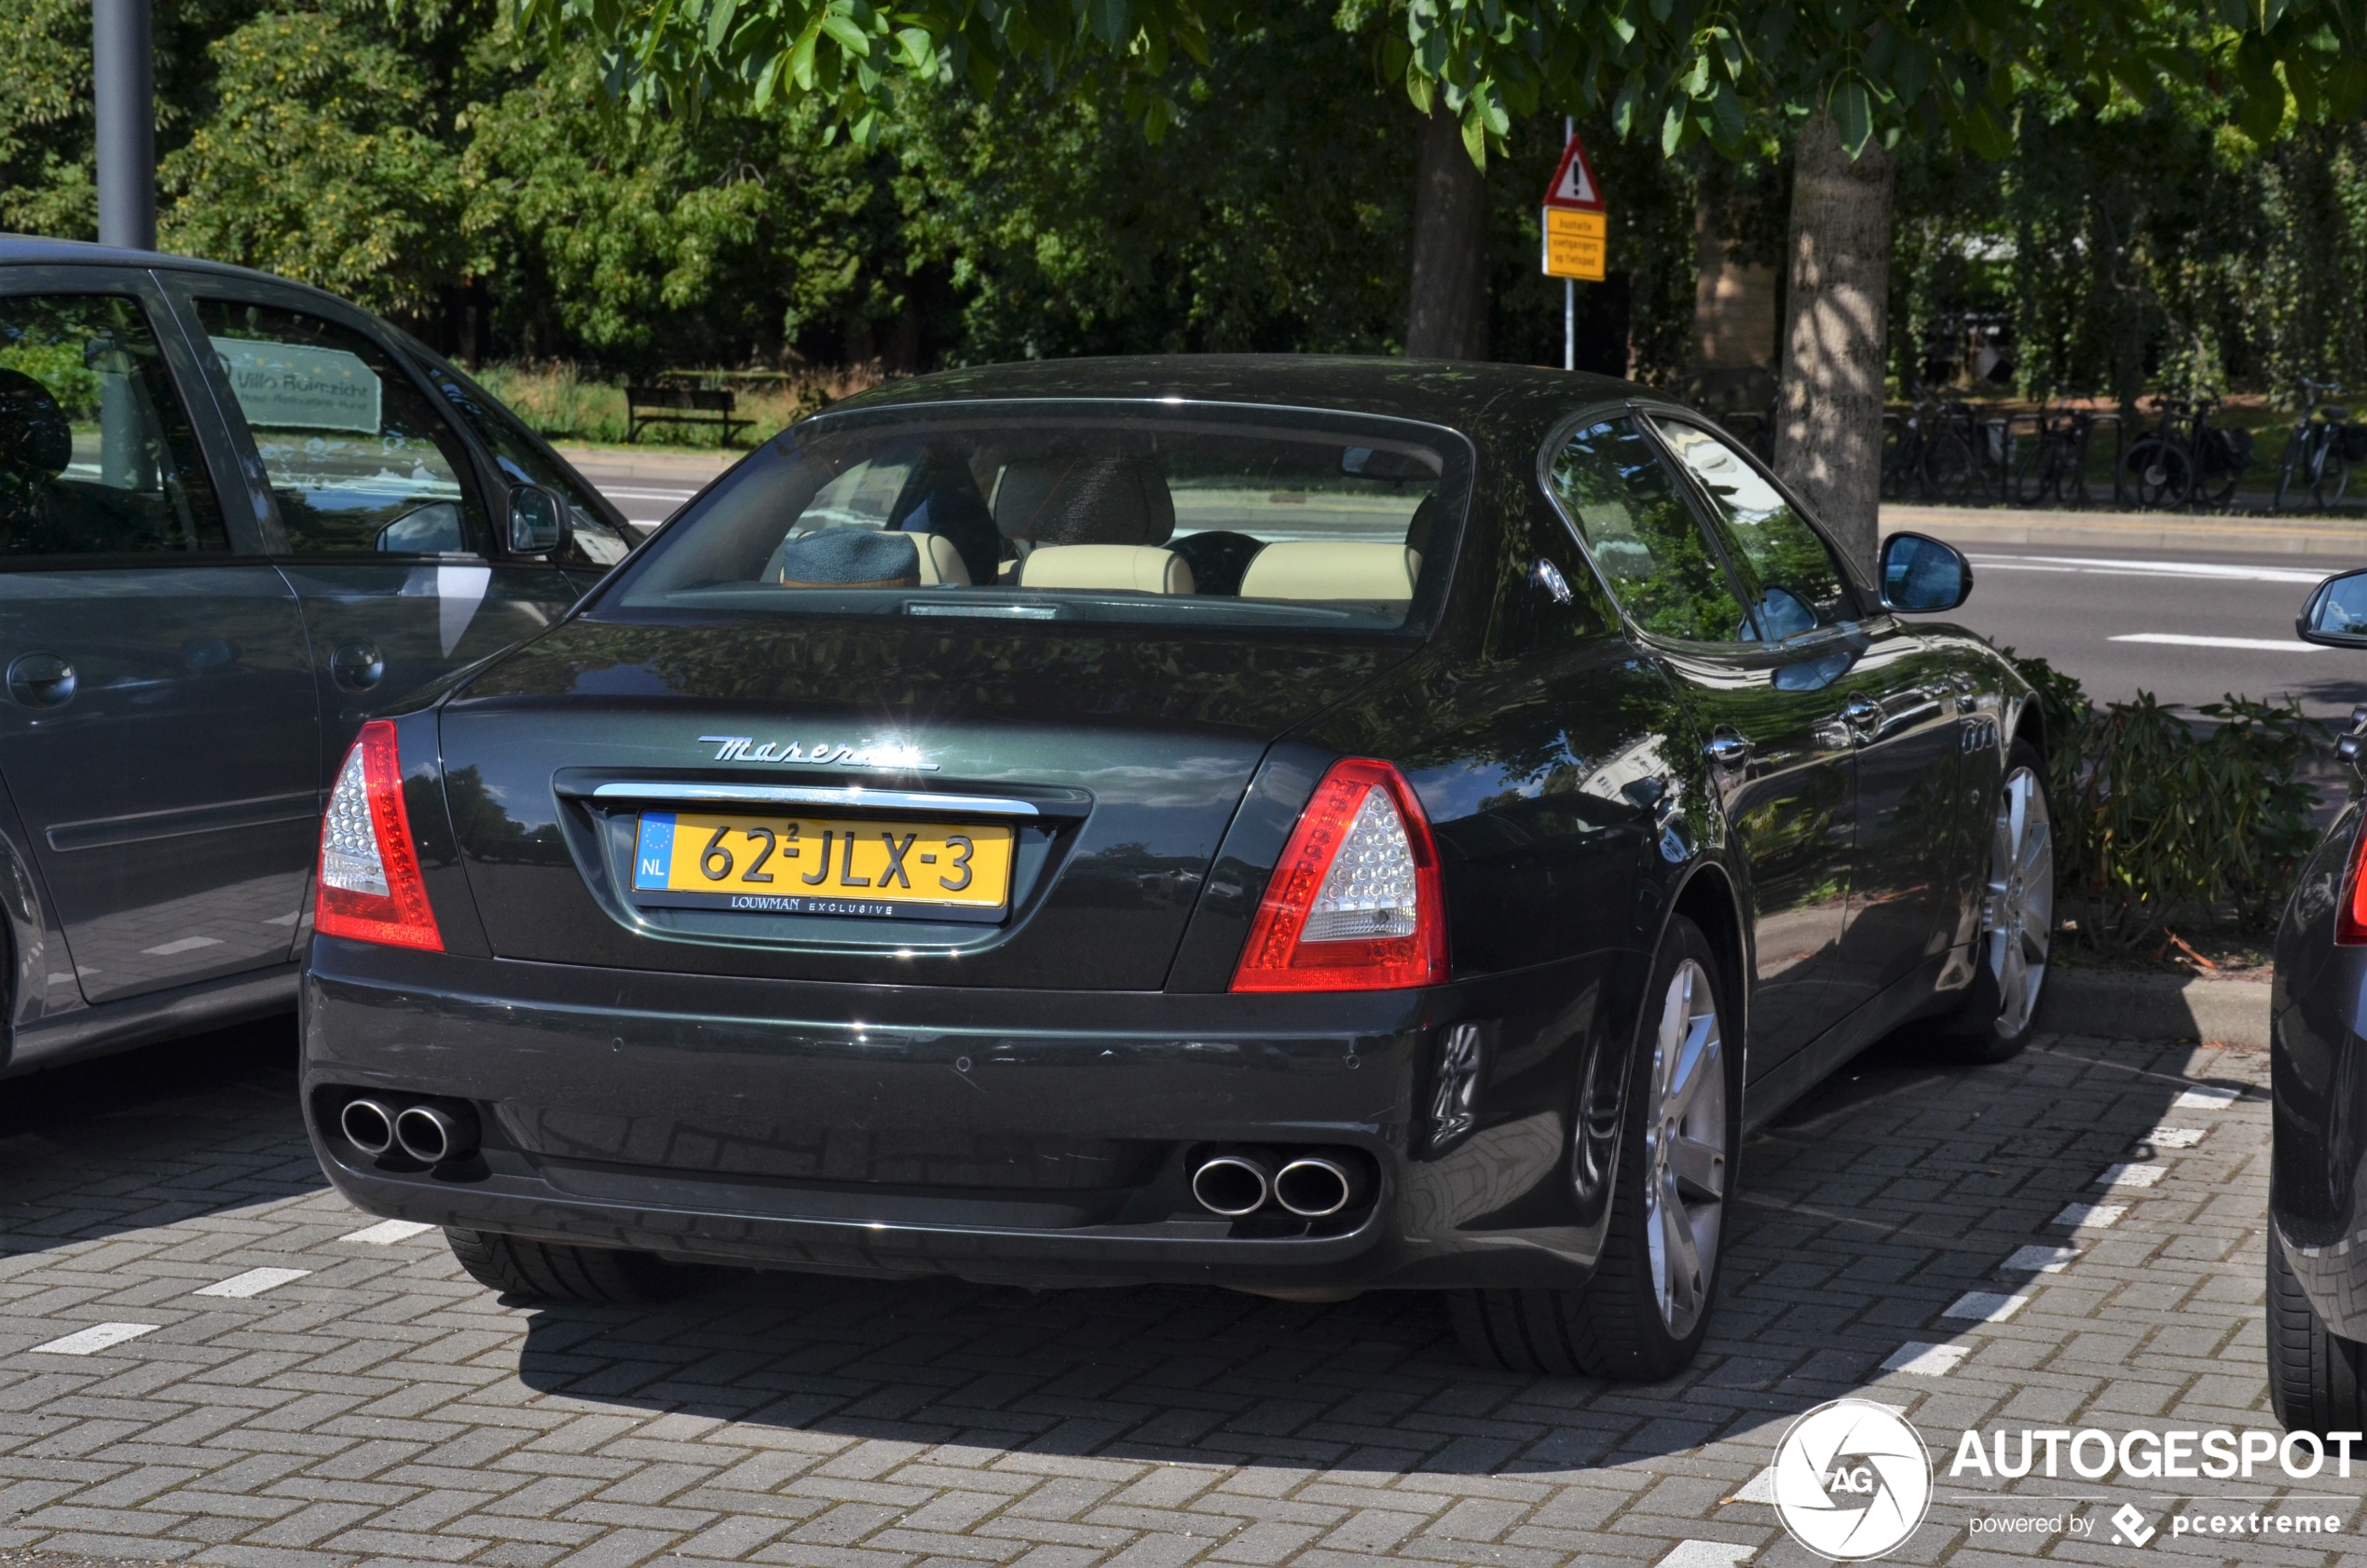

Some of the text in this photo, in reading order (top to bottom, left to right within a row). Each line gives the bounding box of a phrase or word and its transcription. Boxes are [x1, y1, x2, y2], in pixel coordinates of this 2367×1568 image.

[698, 735, 940, 771] Masera
[642, 858, 665, 876] NL
[699, 825, 975, 892] 62-JLX-3
[732, 895, 894, 915] LOUWMAN EXCLUSIVE
